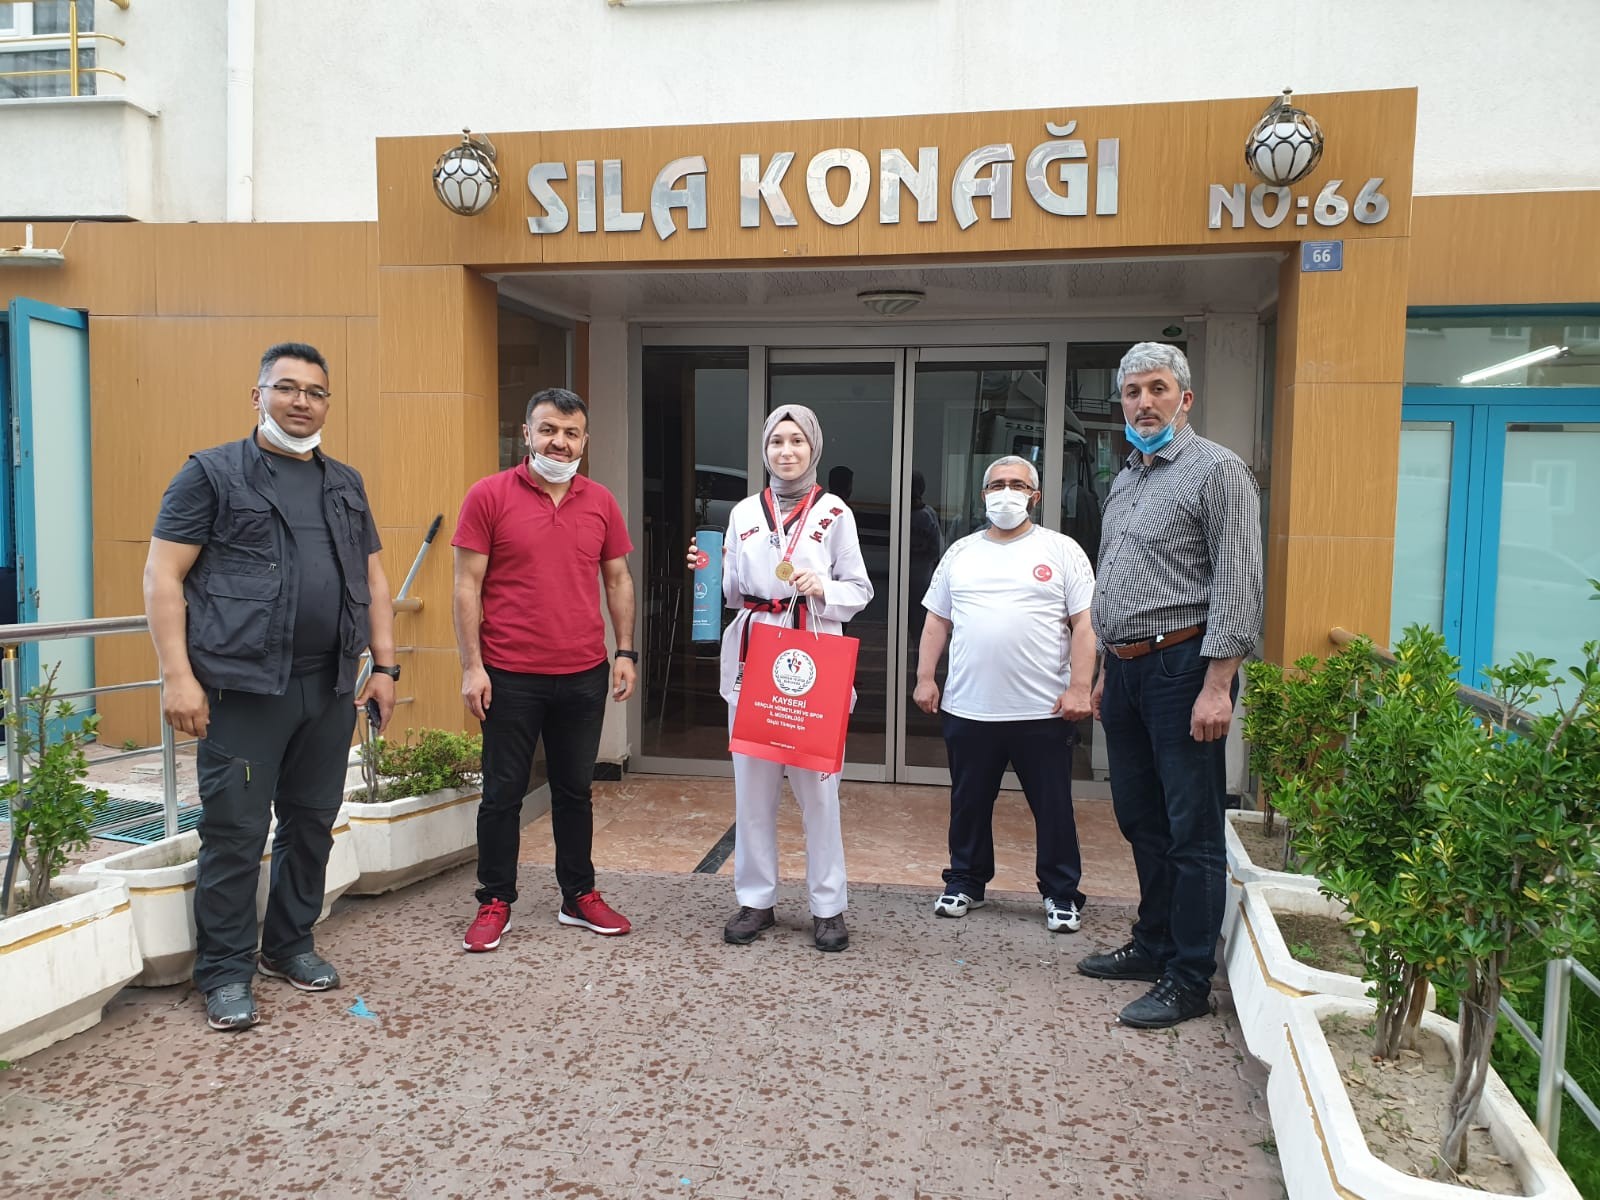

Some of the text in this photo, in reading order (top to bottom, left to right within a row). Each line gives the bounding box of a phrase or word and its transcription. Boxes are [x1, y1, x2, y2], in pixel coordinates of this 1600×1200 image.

[527, 120, 1120, 241] SILA KONAĞI
[1208, 177, 1390, 229] NO:66
[1312, 249, 1331, 263] 66
[772, 695, 806, 708] KAYSERİ
